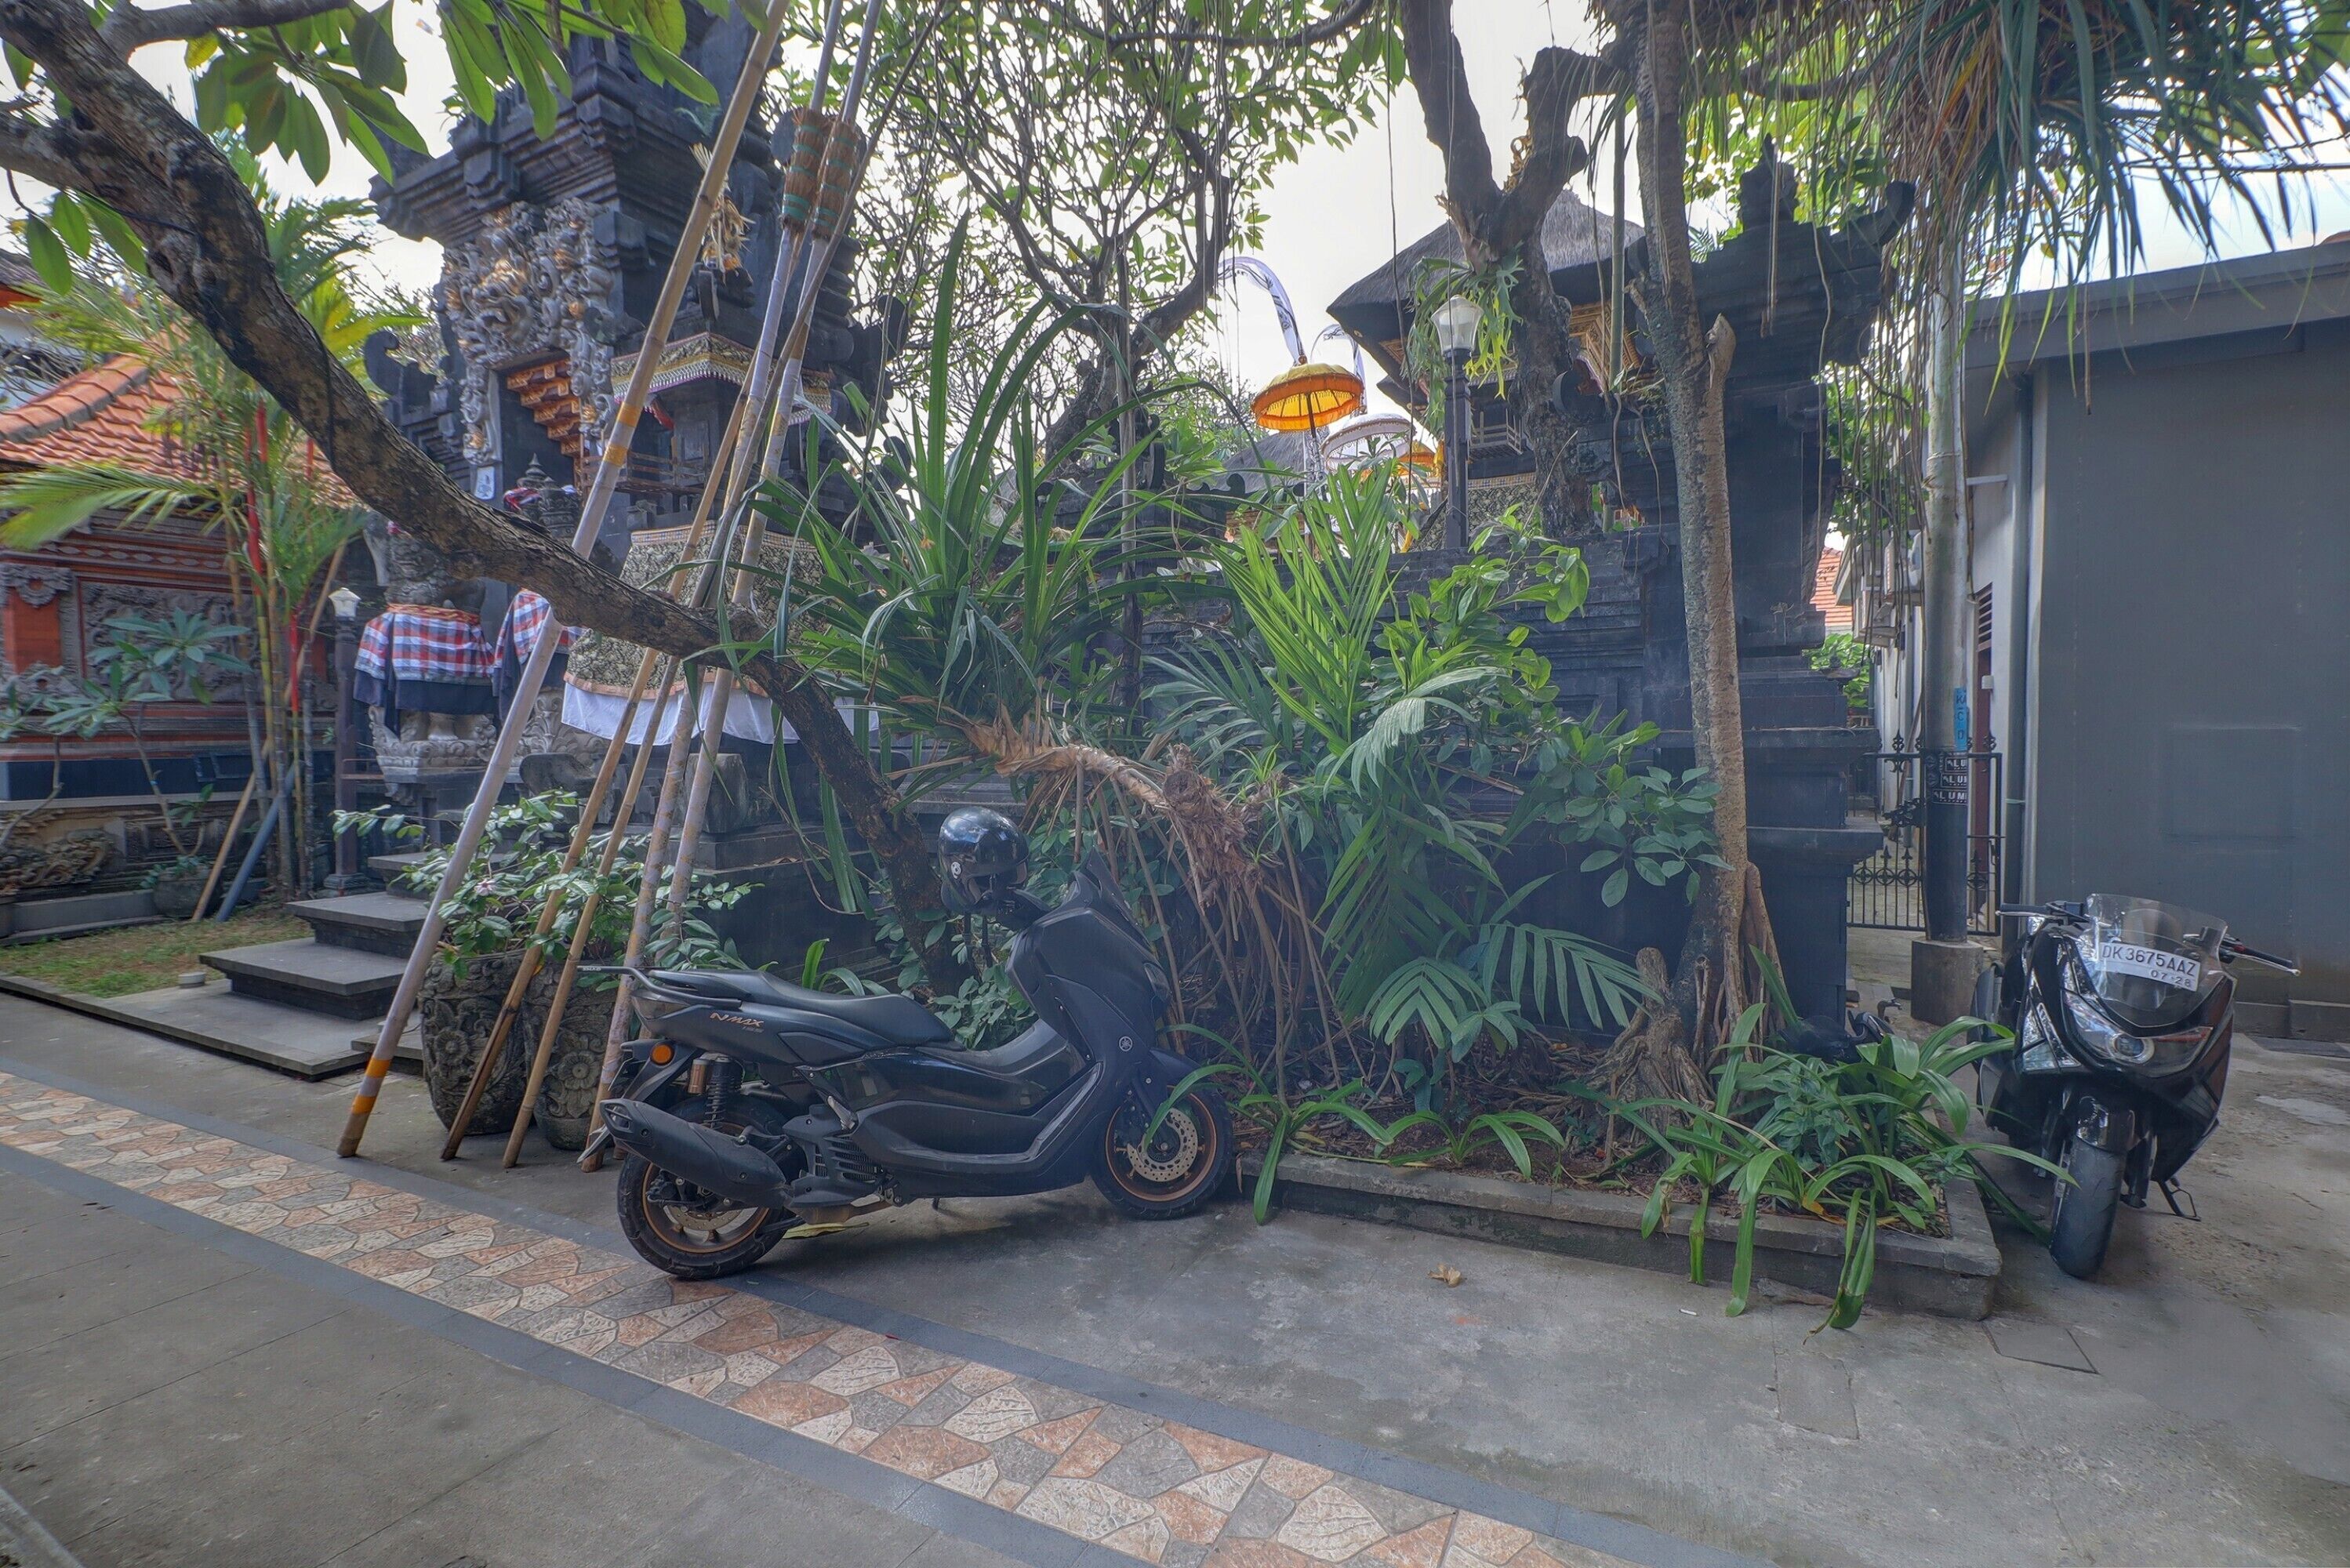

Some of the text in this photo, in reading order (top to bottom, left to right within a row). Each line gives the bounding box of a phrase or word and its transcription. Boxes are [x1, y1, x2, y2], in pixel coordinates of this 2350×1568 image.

[2102, 945, 2196, 977] DK 3675 AAZ
[709, 1012, 765, 1027] NMAX
